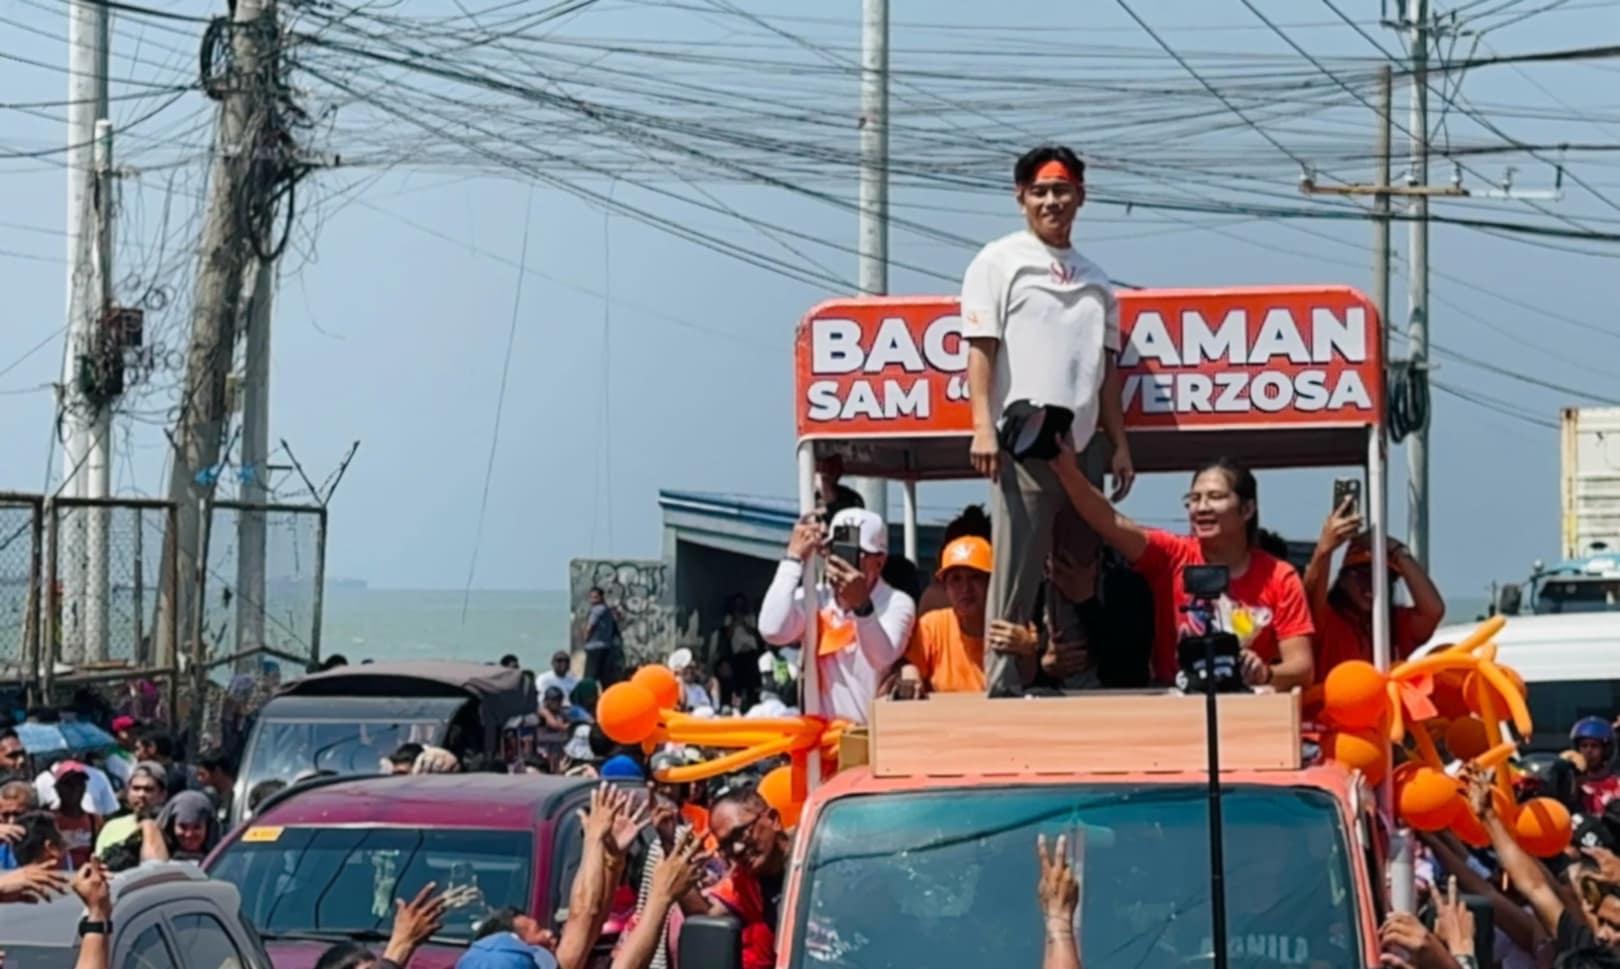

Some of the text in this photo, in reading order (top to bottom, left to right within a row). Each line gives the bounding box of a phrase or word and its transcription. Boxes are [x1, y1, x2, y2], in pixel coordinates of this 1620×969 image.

[812, 306, 1366, 373] BAG AMAN
[808, 379, 930, 421] SAM
